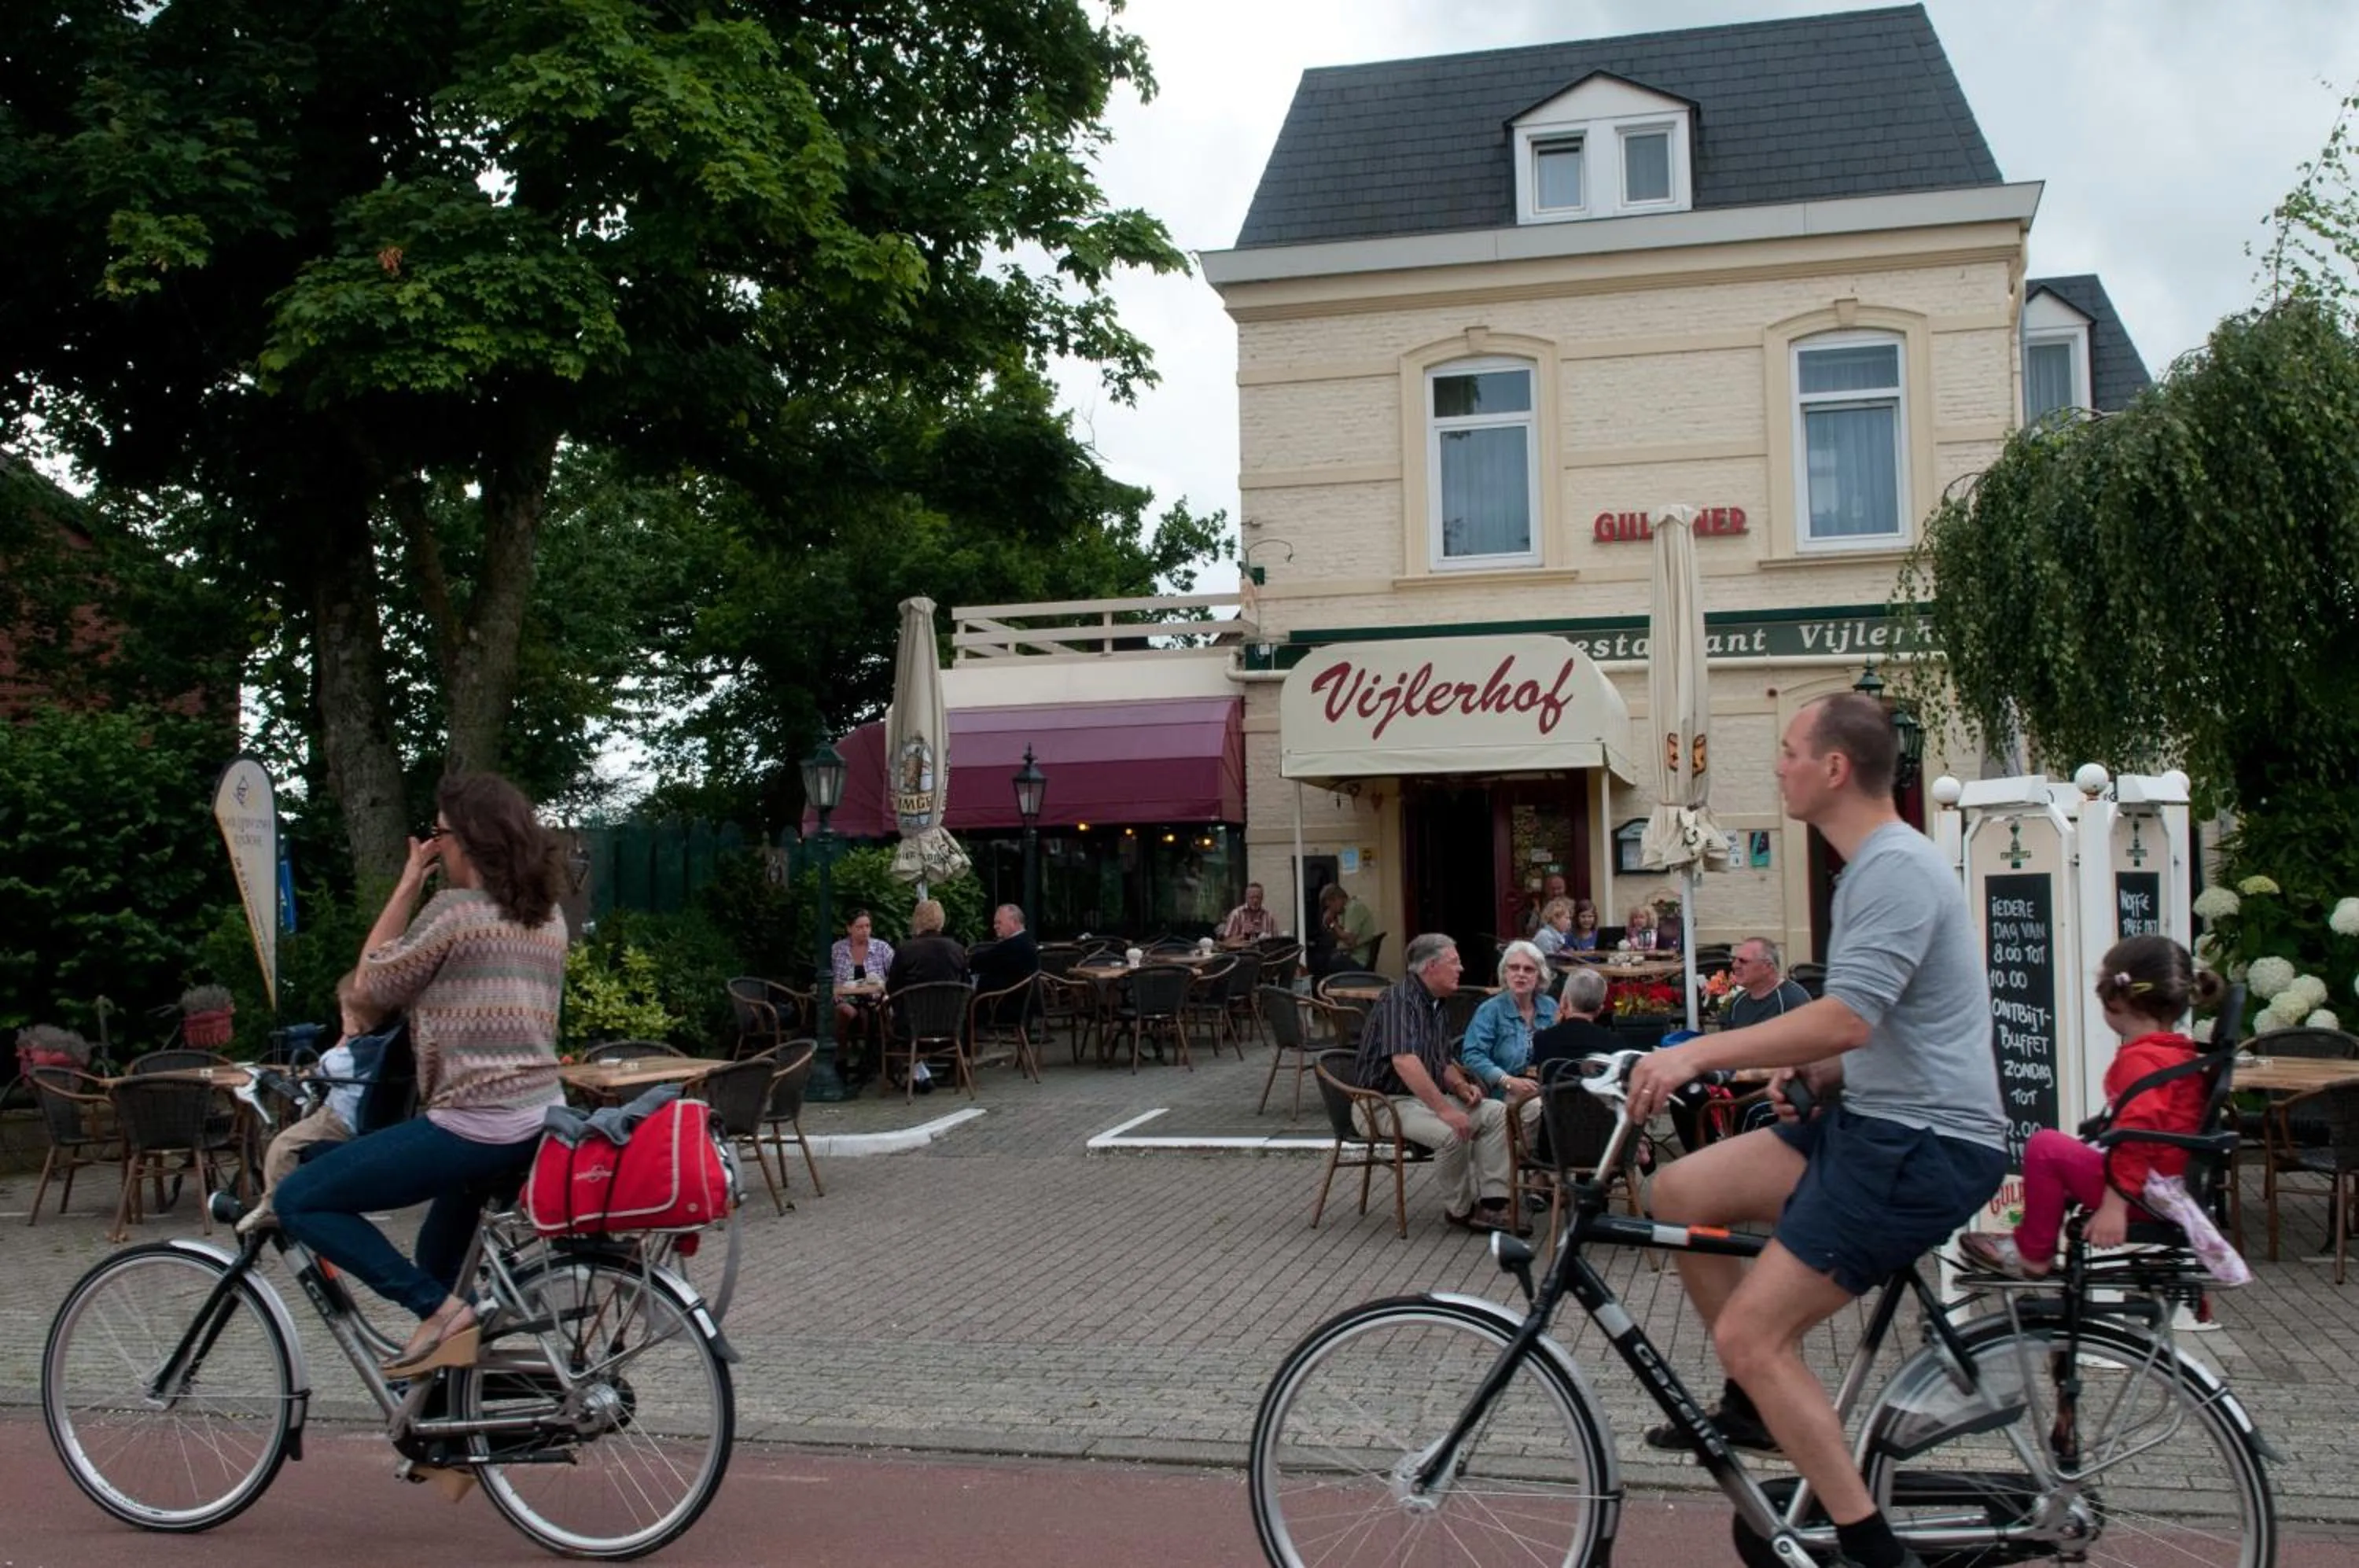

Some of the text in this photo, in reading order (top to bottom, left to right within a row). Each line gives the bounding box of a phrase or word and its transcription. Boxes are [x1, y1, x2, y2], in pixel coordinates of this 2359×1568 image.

[1594, 507, 1747, 543] GULNER
[1573, 628, 1767, 658] estaant
[1311, 654, 1573, 740] Vijlerhof
[1993, 943, 2046, 965] 8.00 TOT
[2010, 1088, 2038, 1106] TOT
